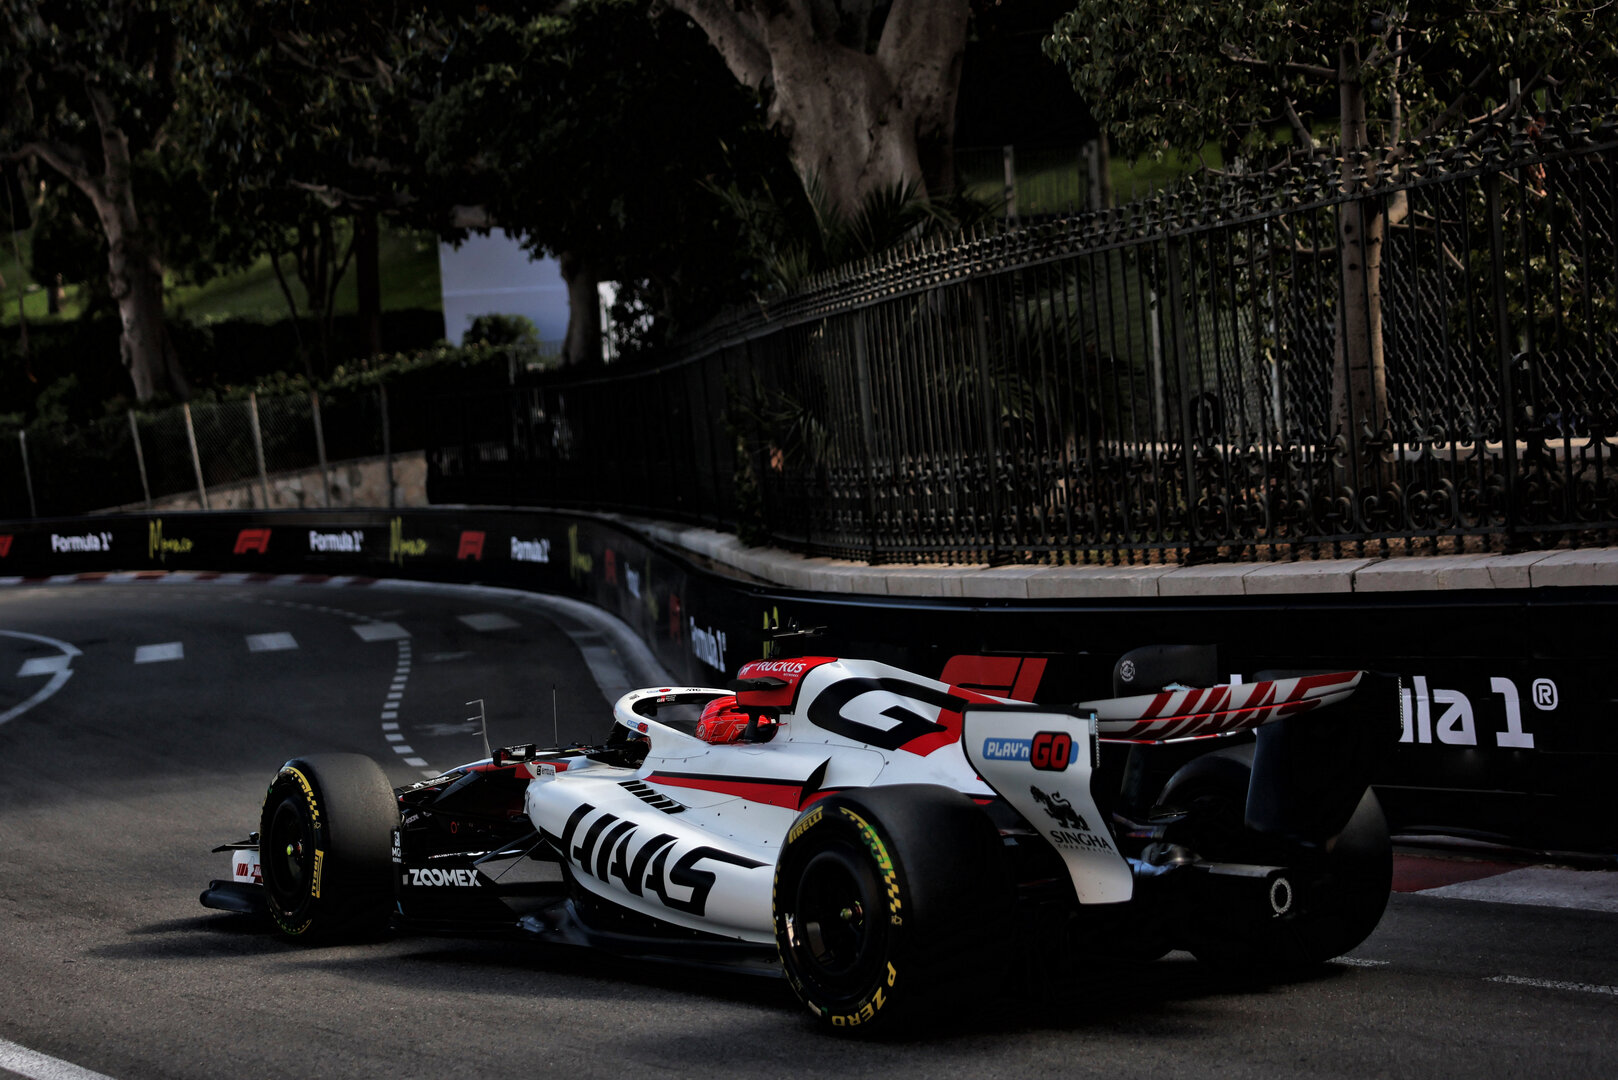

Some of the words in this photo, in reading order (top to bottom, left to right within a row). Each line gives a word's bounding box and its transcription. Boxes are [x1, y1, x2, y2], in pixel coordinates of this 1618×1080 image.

[756, 661, 807, 674] RUCKUS
[1031, 732, 1071, 771] GO
[788, 805, 824, 845] PIRELLI
[1050, 830, 1112, 850] SINGHA
[408, 868, 482, 888] ZOOMEX
[886, 960, 898, 988] P
[831, 986, 888, 1028] ZERO
